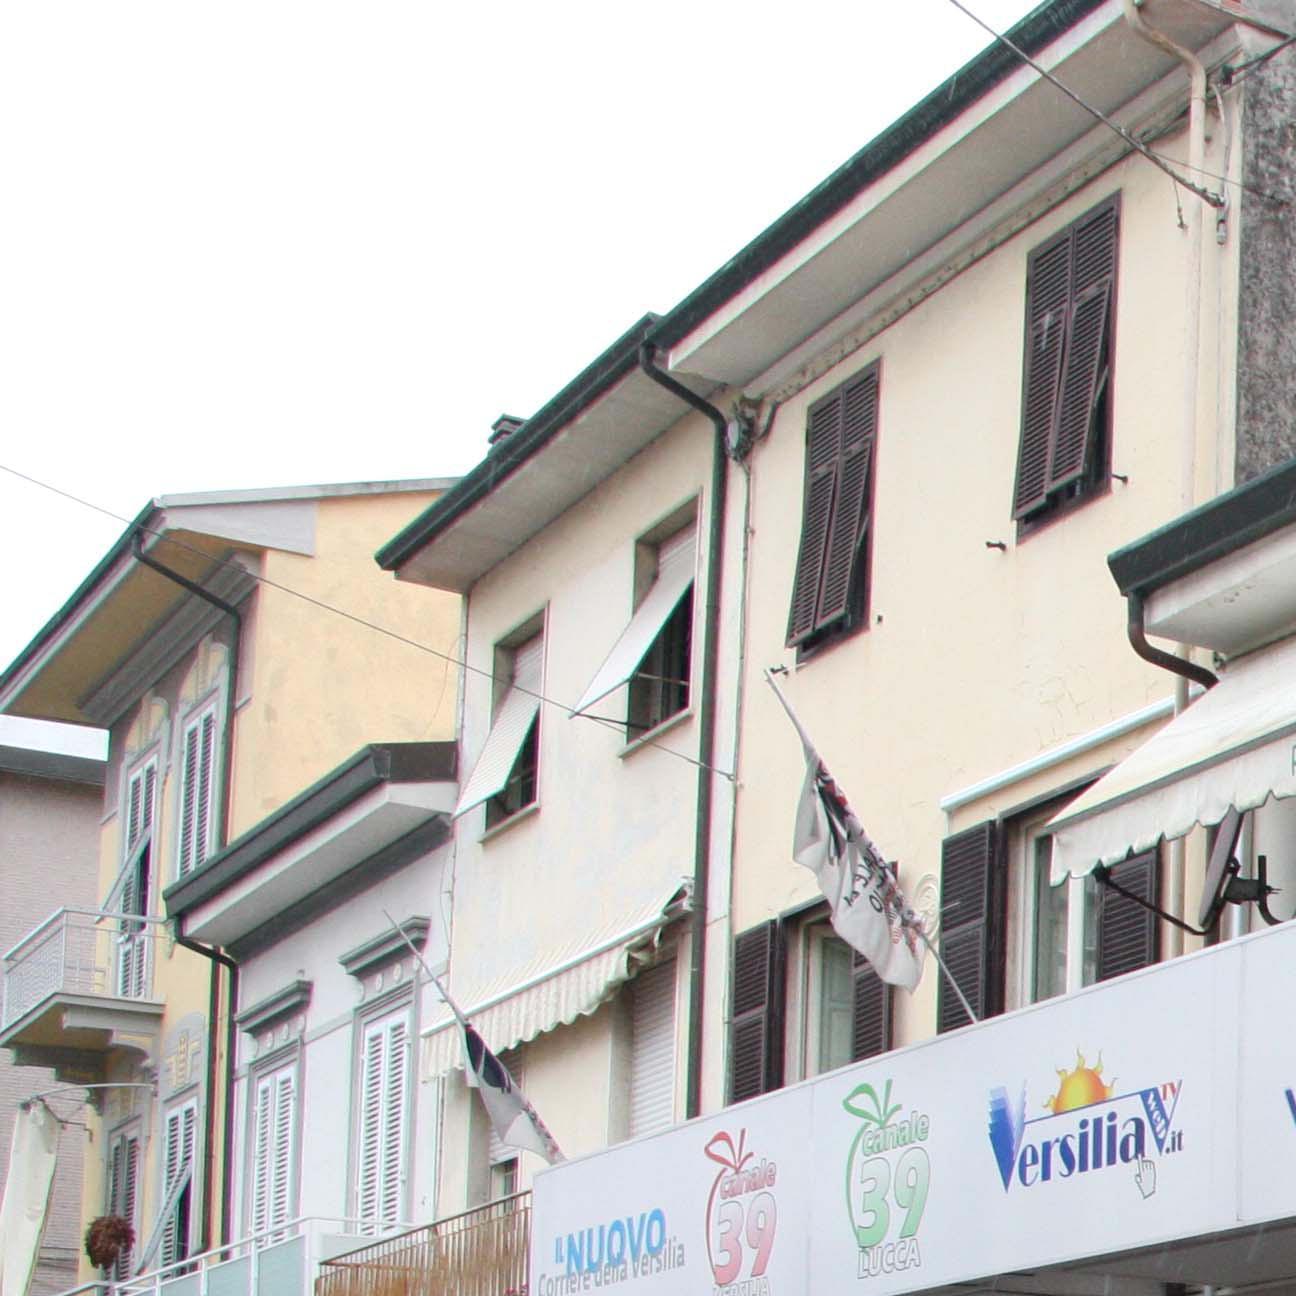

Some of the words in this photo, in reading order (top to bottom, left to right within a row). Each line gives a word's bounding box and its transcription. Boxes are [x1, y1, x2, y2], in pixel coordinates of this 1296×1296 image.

[861, 1110, 930, 1157] canale
[988, 1080, 1146, 1194] Versilia
[719, 1158, 777, 1200] canale
[857, 1146, 931, 1248] 39
[566, 1208, 667, 1278] NUOVO
[715, 1191, 777, 1287] 39
[856, 1238, 922, 1280] LUCCA
